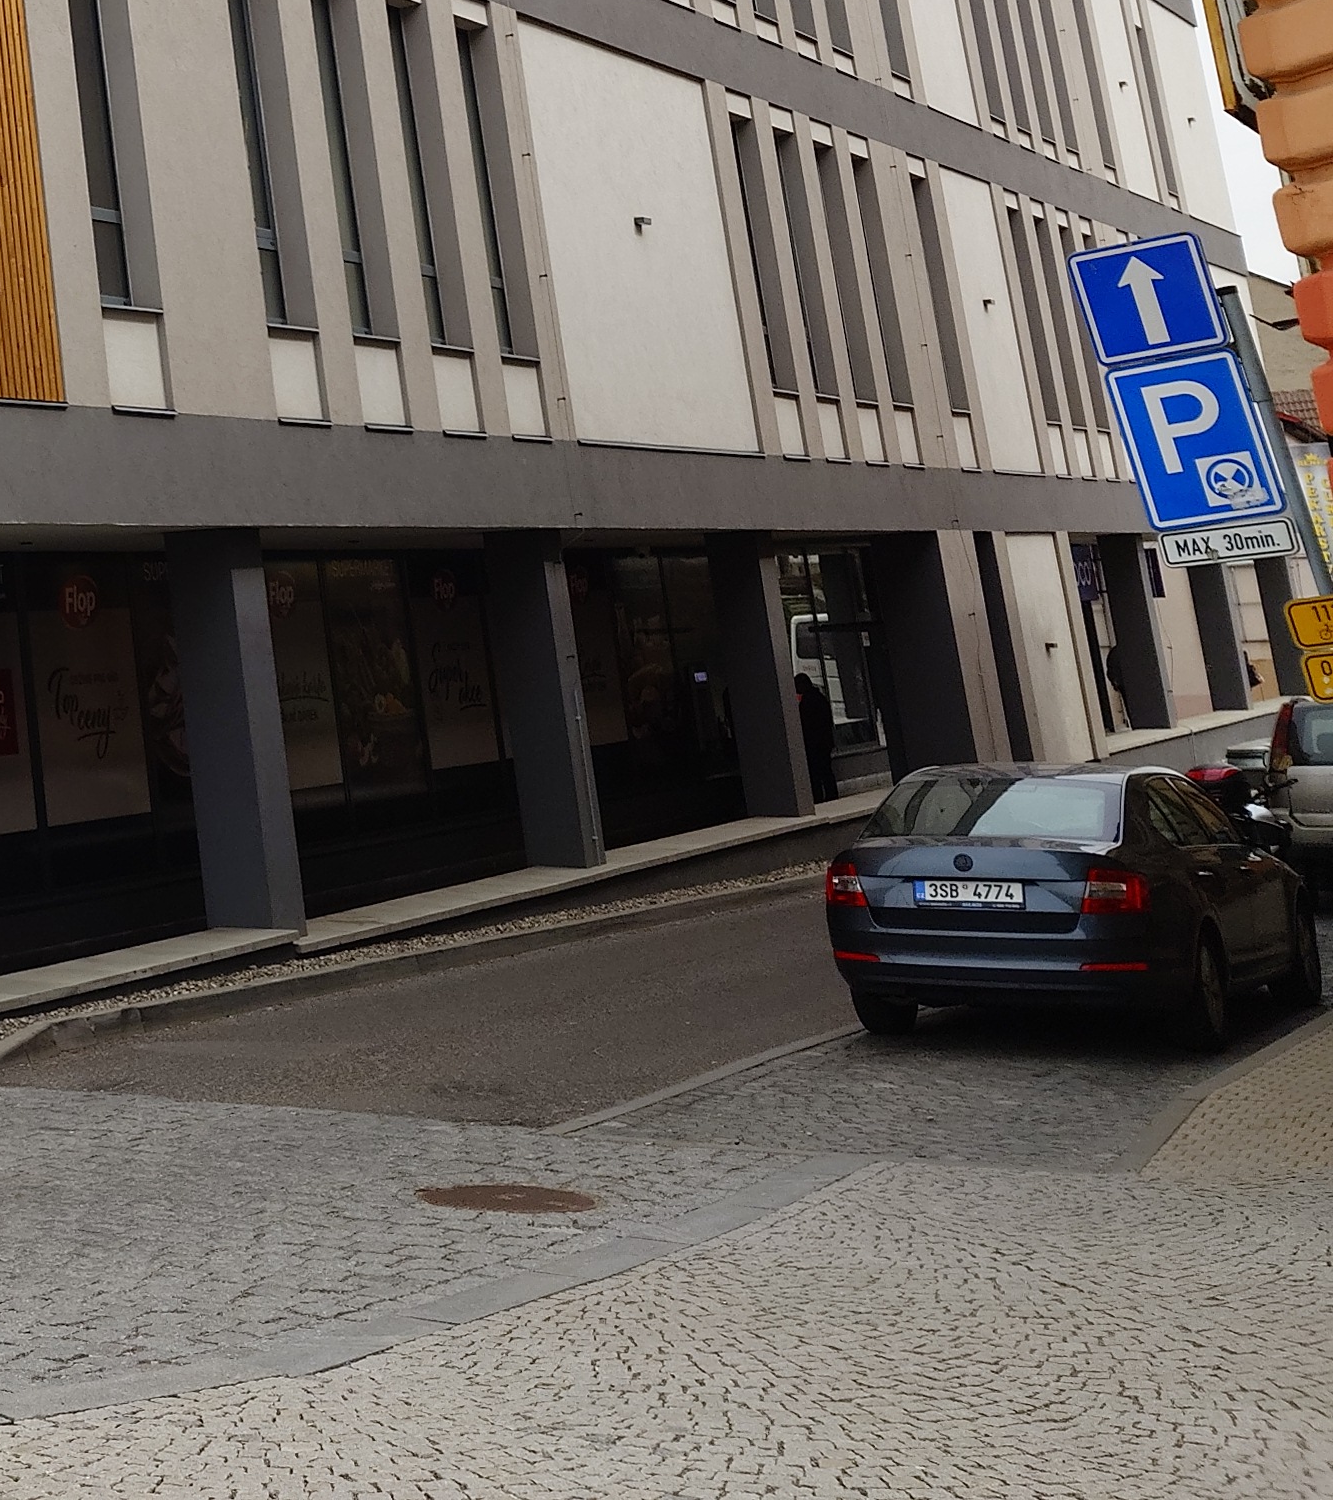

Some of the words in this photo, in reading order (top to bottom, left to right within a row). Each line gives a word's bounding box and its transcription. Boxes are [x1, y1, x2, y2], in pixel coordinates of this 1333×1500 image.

[1141, 380, 1220, 475] P
[1223, 530, 1280, 551] 30min.
[64, 586, 97, 617] Flop
[1311, 604, 1333, 622] 11
[929, 883, 959, 899] 3SB
[973, 884, 1015, 900] 4774
